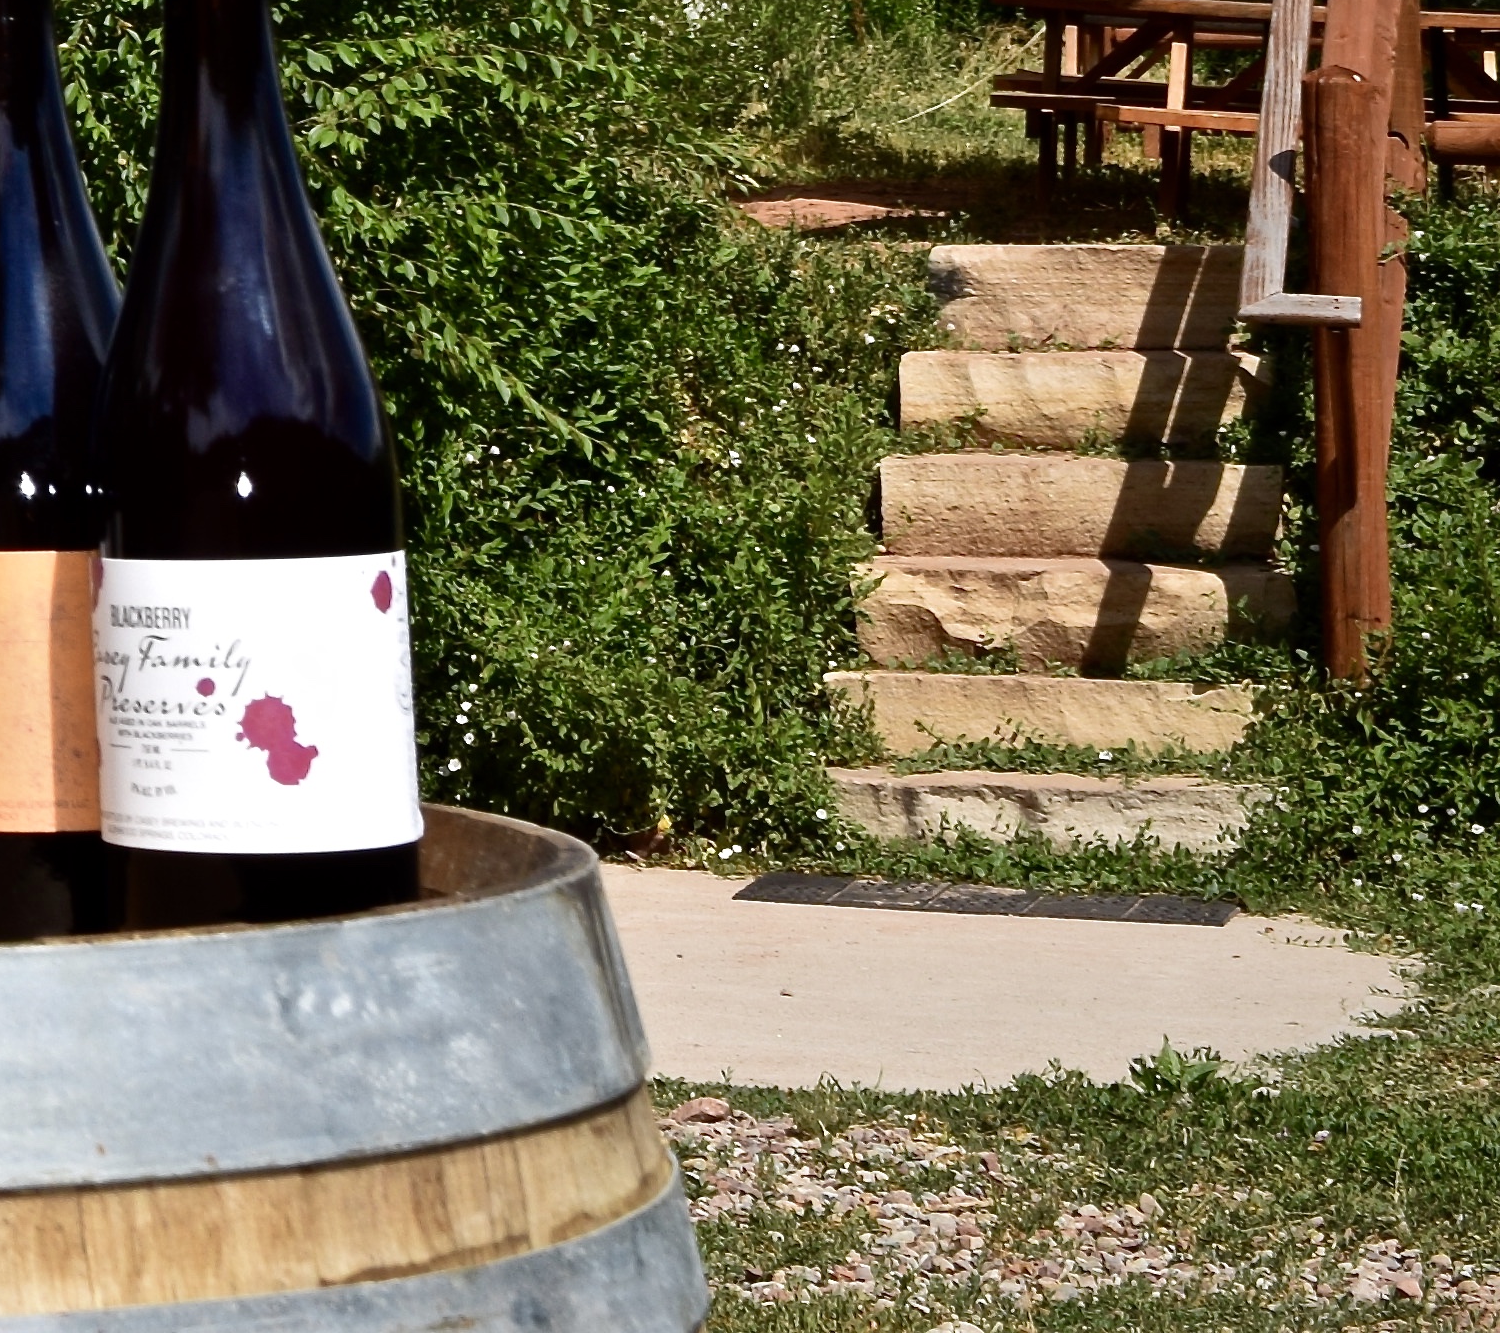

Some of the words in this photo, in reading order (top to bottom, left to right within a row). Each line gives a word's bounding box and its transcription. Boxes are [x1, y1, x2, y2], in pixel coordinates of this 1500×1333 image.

[109, 604, 192, 629] BLACKBERRY
[138, 634, 252, 697] Family
[99, 674, 227, 716] Preserves
